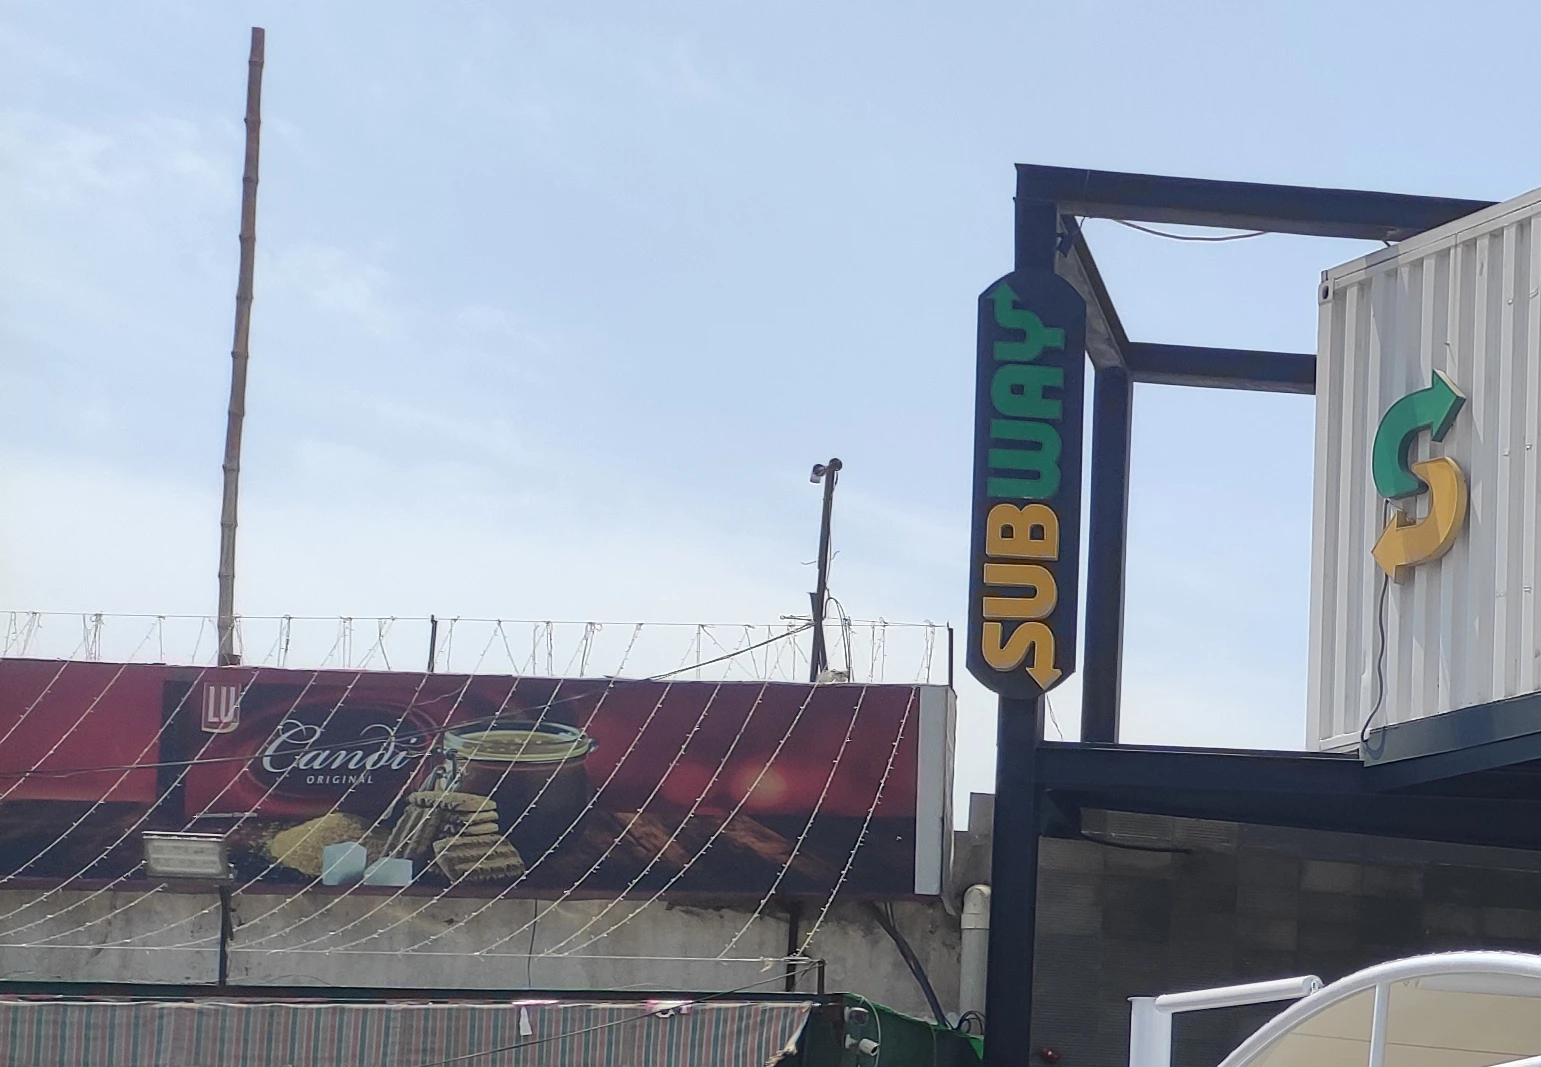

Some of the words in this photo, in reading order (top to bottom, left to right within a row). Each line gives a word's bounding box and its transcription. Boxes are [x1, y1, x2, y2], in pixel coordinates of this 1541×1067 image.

[981, 281, 1066, 691] SUBWAY
[207, 685, 236, 723] LU
[262, 719, 418, 773] Candi
[306, 775, 374, 784] ORIGINAL
